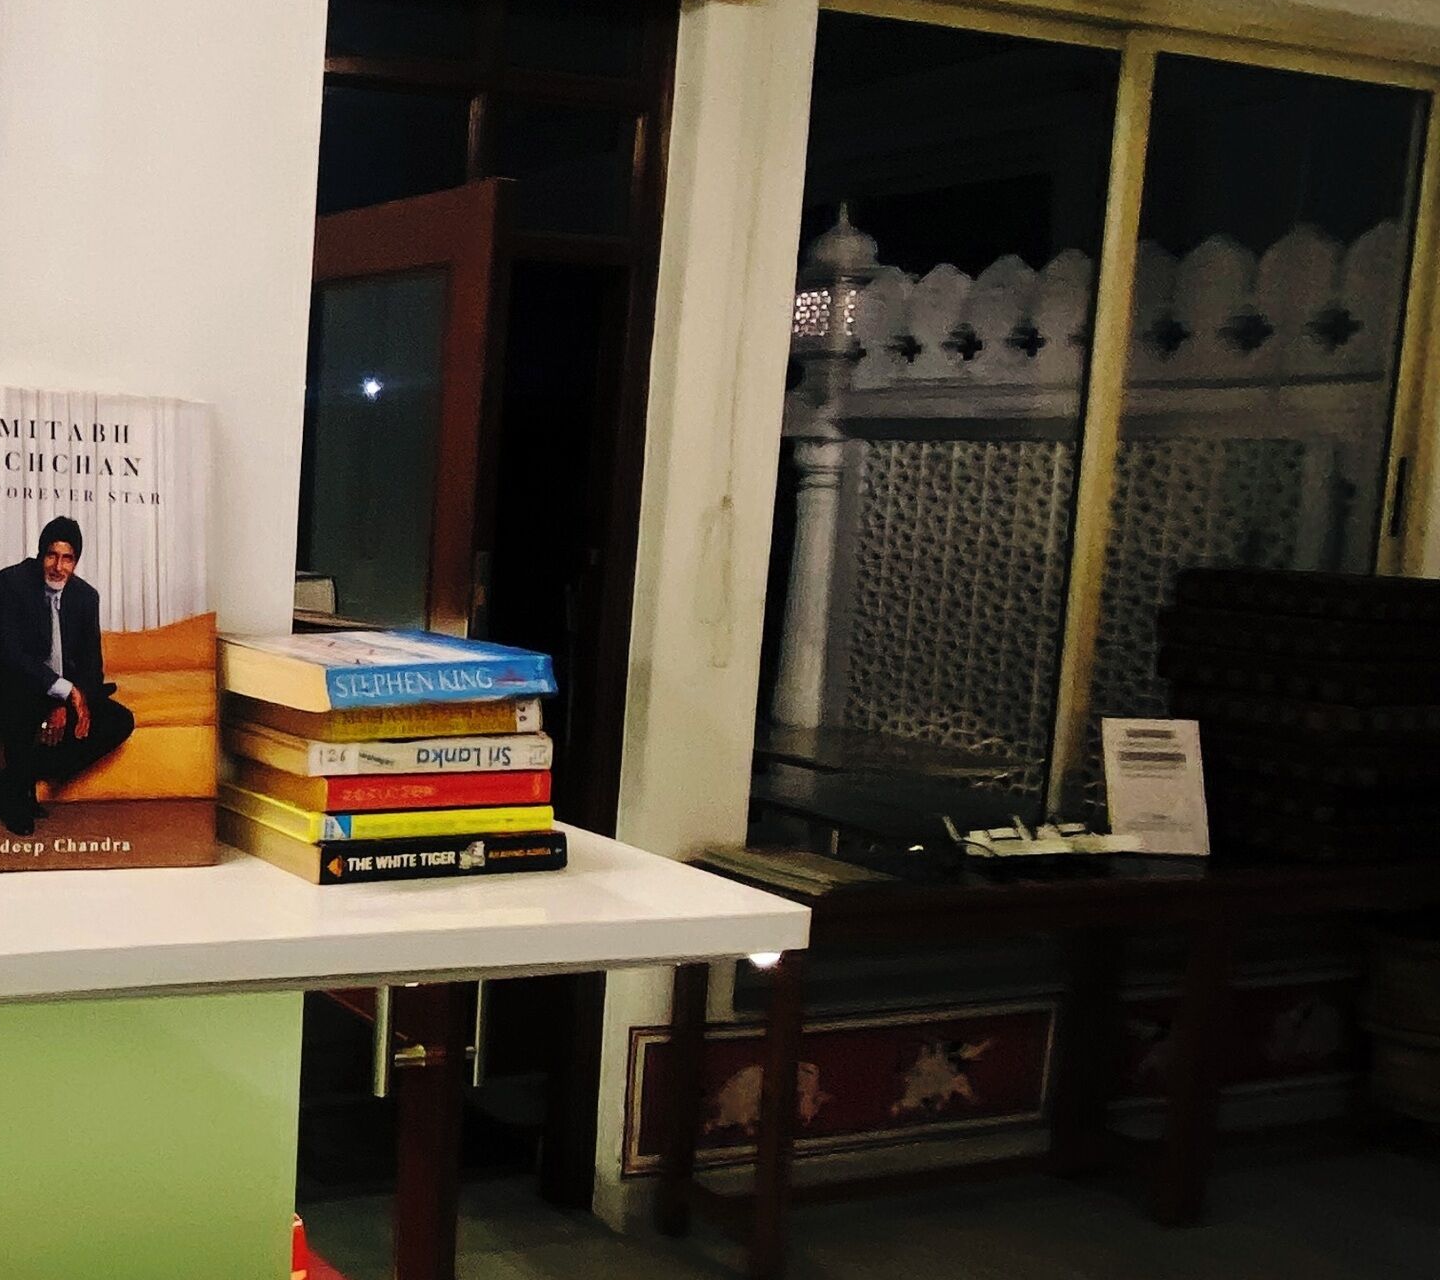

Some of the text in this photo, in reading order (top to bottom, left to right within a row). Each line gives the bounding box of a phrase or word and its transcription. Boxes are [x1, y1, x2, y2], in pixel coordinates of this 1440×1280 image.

[108, 491, 161, 505] STAR
[334, 668, 494, 699] STEPHEN KING
[417, 748, 481, 768] Lanka
[489, 748, 511, 767] Sri
[54, 837, 132, 854] Chandra
[347, 851, 456, 871] THE WHITE TIGER
